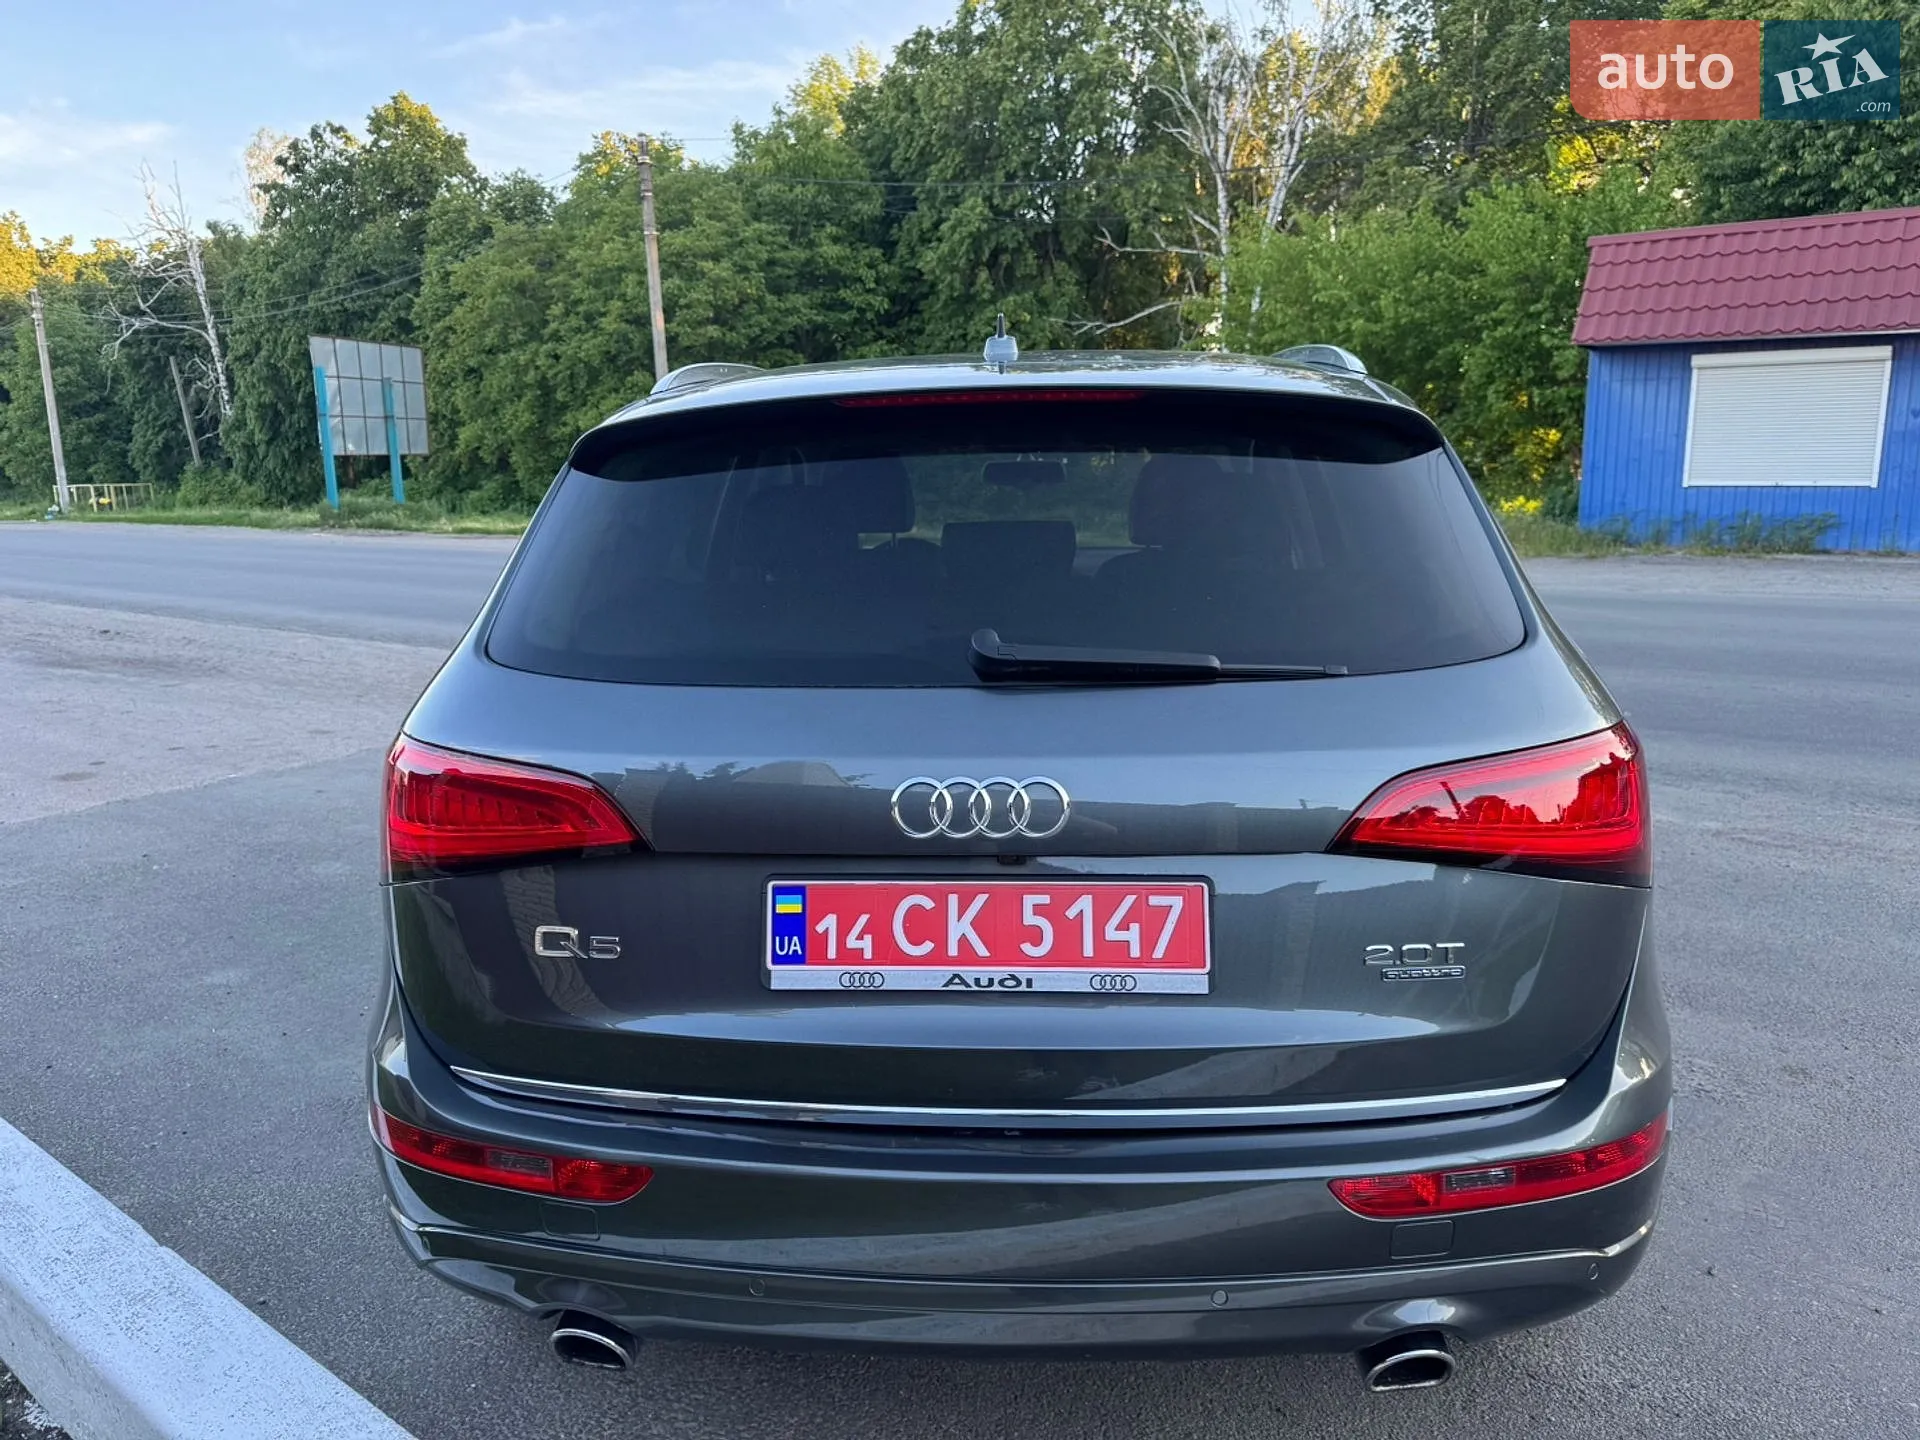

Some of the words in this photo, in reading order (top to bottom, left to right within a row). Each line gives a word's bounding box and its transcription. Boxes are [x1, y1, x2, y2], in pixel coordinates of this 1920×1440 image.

[814, 913, 873, 960] 14
[892, 893, 991, 958] CK
[1018, 894, 1185, 959] 5147
[534, 925, 621, 959] Q5
[775, 935, 803, 956] UA
[1364, 942, 1465, 965] 2.0T
[941, 973, 1034, 989] Audi
